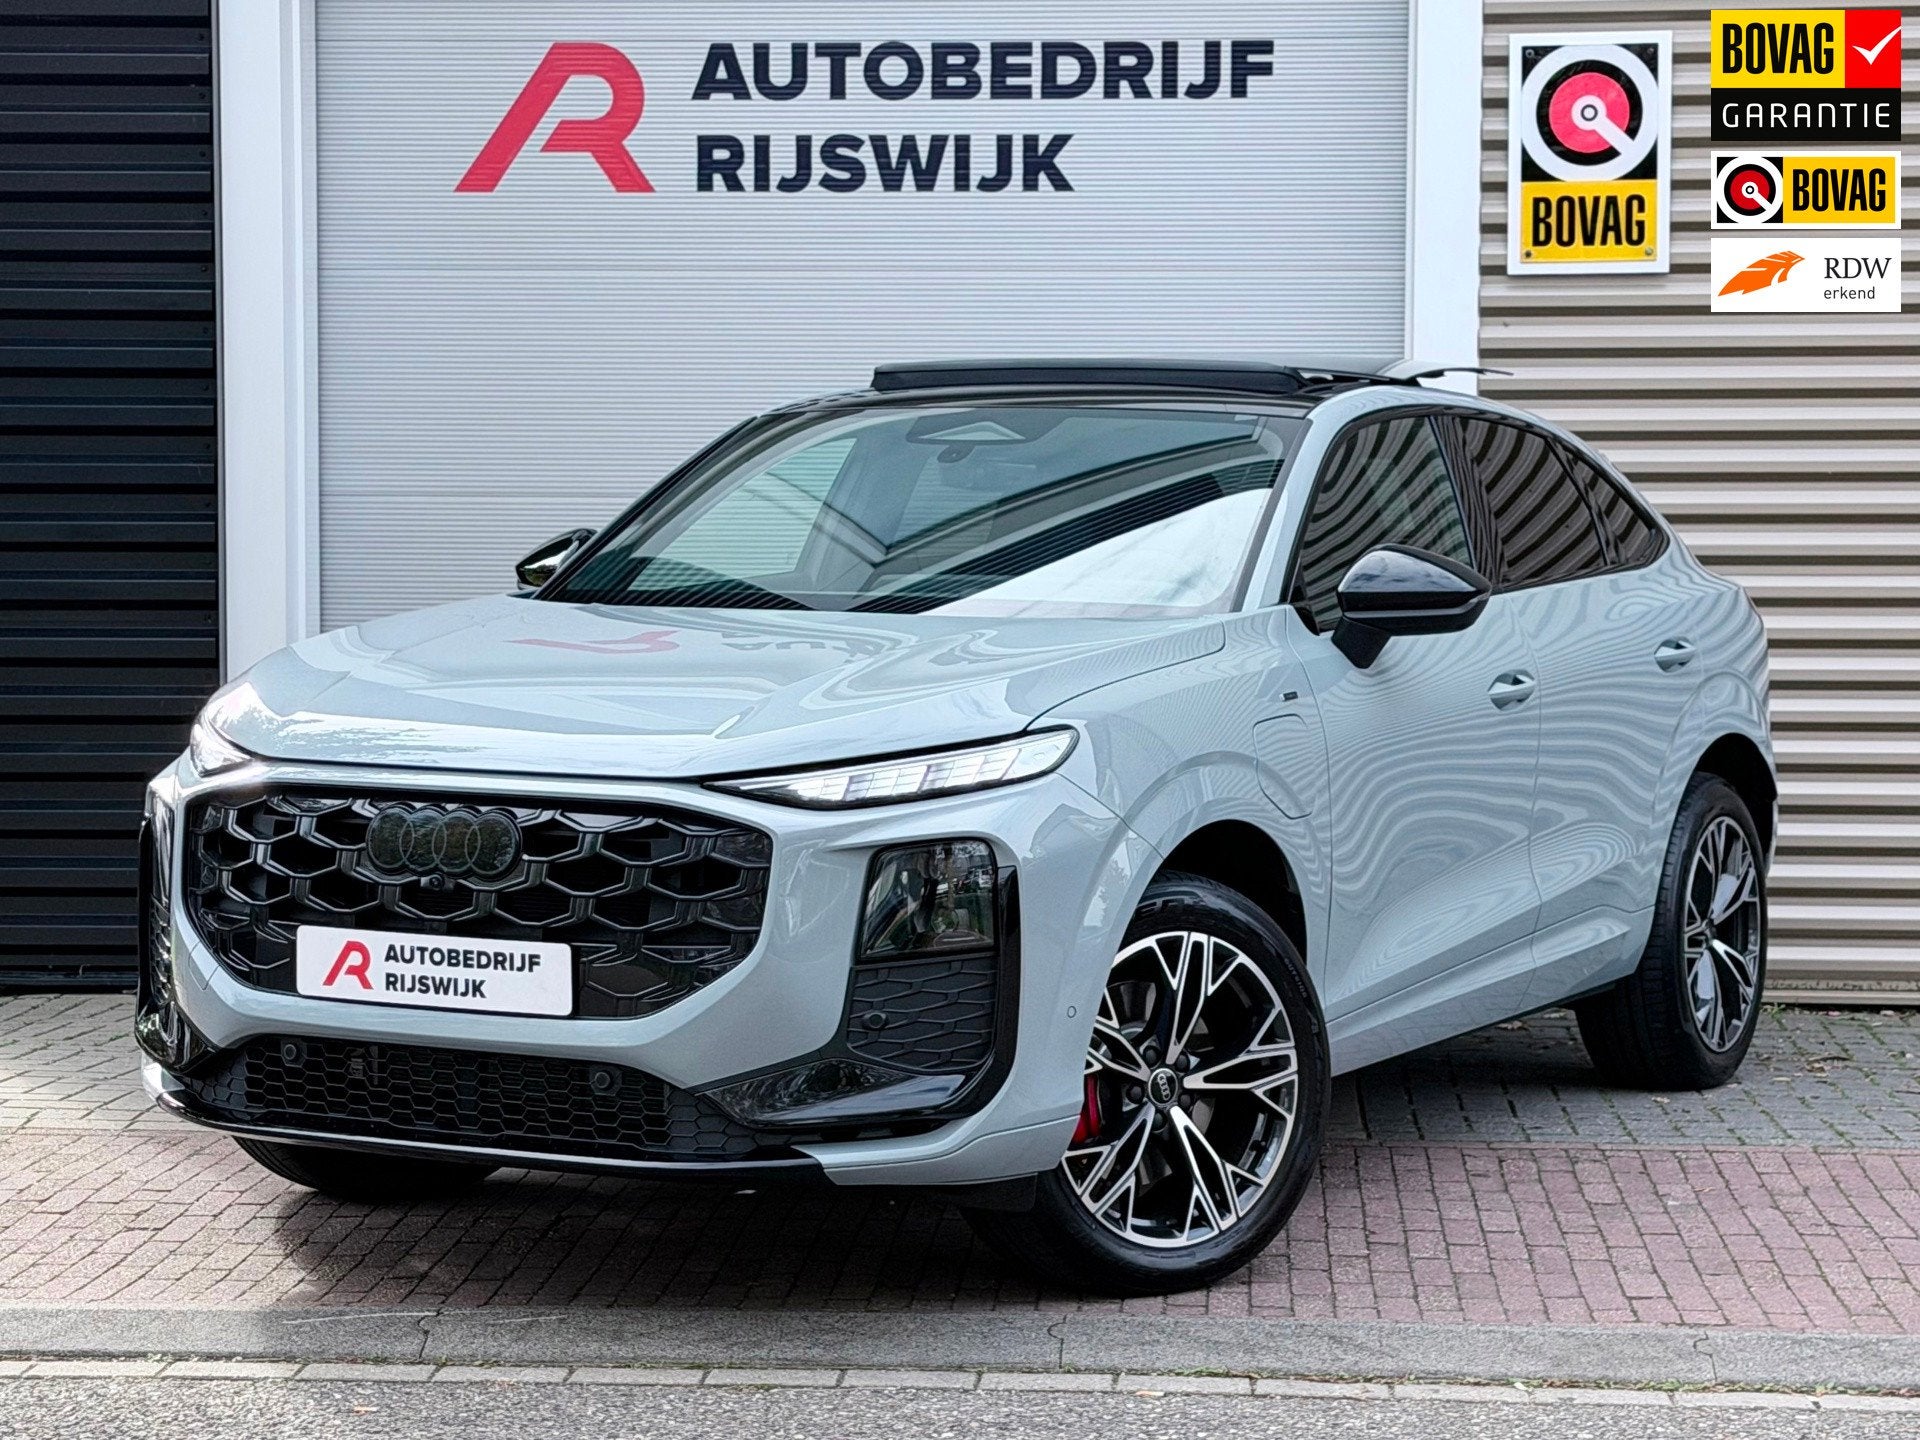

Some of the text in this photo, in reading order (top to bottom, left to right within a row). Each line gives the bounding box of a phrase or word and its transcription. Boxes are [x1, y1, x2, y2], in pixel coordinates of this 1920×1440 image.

[691, 40, 1275, 101] AUTOBEDRIJF
[696, 133, 1075, 193] RIJSWIJK
[1531, 194, 1646, 248] BOVAG
[384, 943, 541, 973] AUTOBEDRIJF
[384, 972, 487, 999] RIJSWIJK
